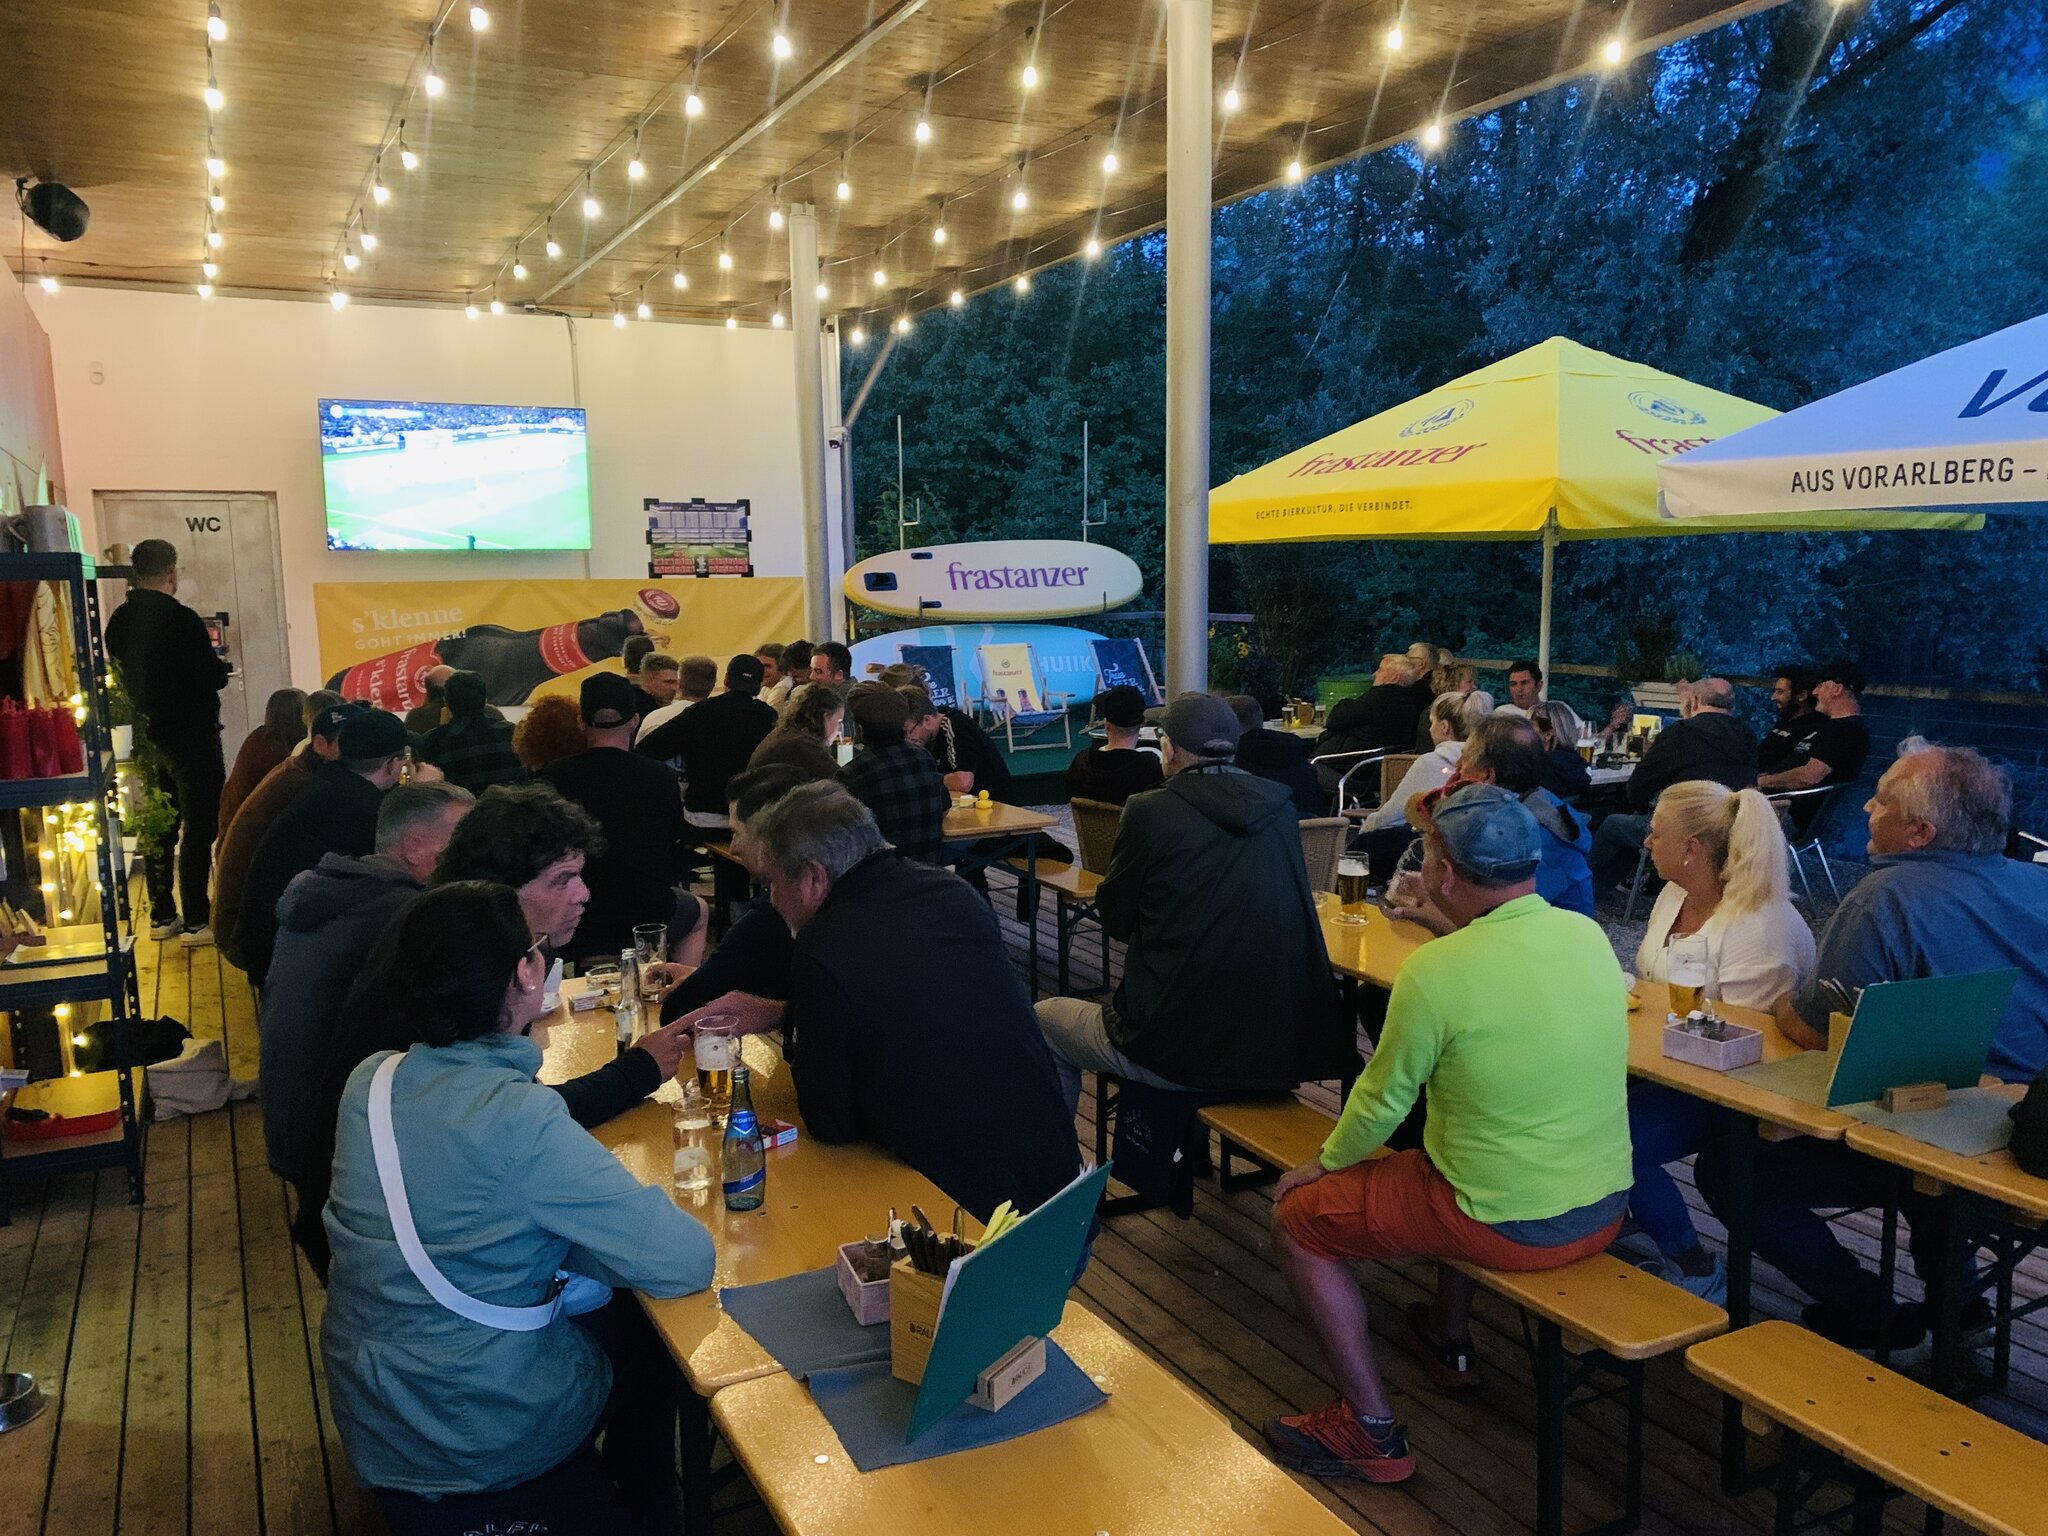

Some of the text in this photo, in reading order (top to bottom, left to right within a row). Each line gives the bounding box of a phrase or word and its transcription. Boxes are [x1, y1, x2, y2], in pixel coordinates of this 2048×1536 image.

[1288, 442, 1488, 478] frastanzer
[1791, 469, 1834, 493] AUS
[1842, 457, 2014, 490] VORARLBERG
[1256, 509, 1280, 520] ECHTE
[1339, 503, 1354, 513] DIE
[1357, 500, 1413, 511] VERBINDET.
[185, 517, 221, 532] WC
[945, 561, 1089, 590] frastanzer
[351, 606, 464, 634] s'klenne
[355, 629, 467, 650] GOHT IMMER!
[395, 647, 417, 709] frastanz
